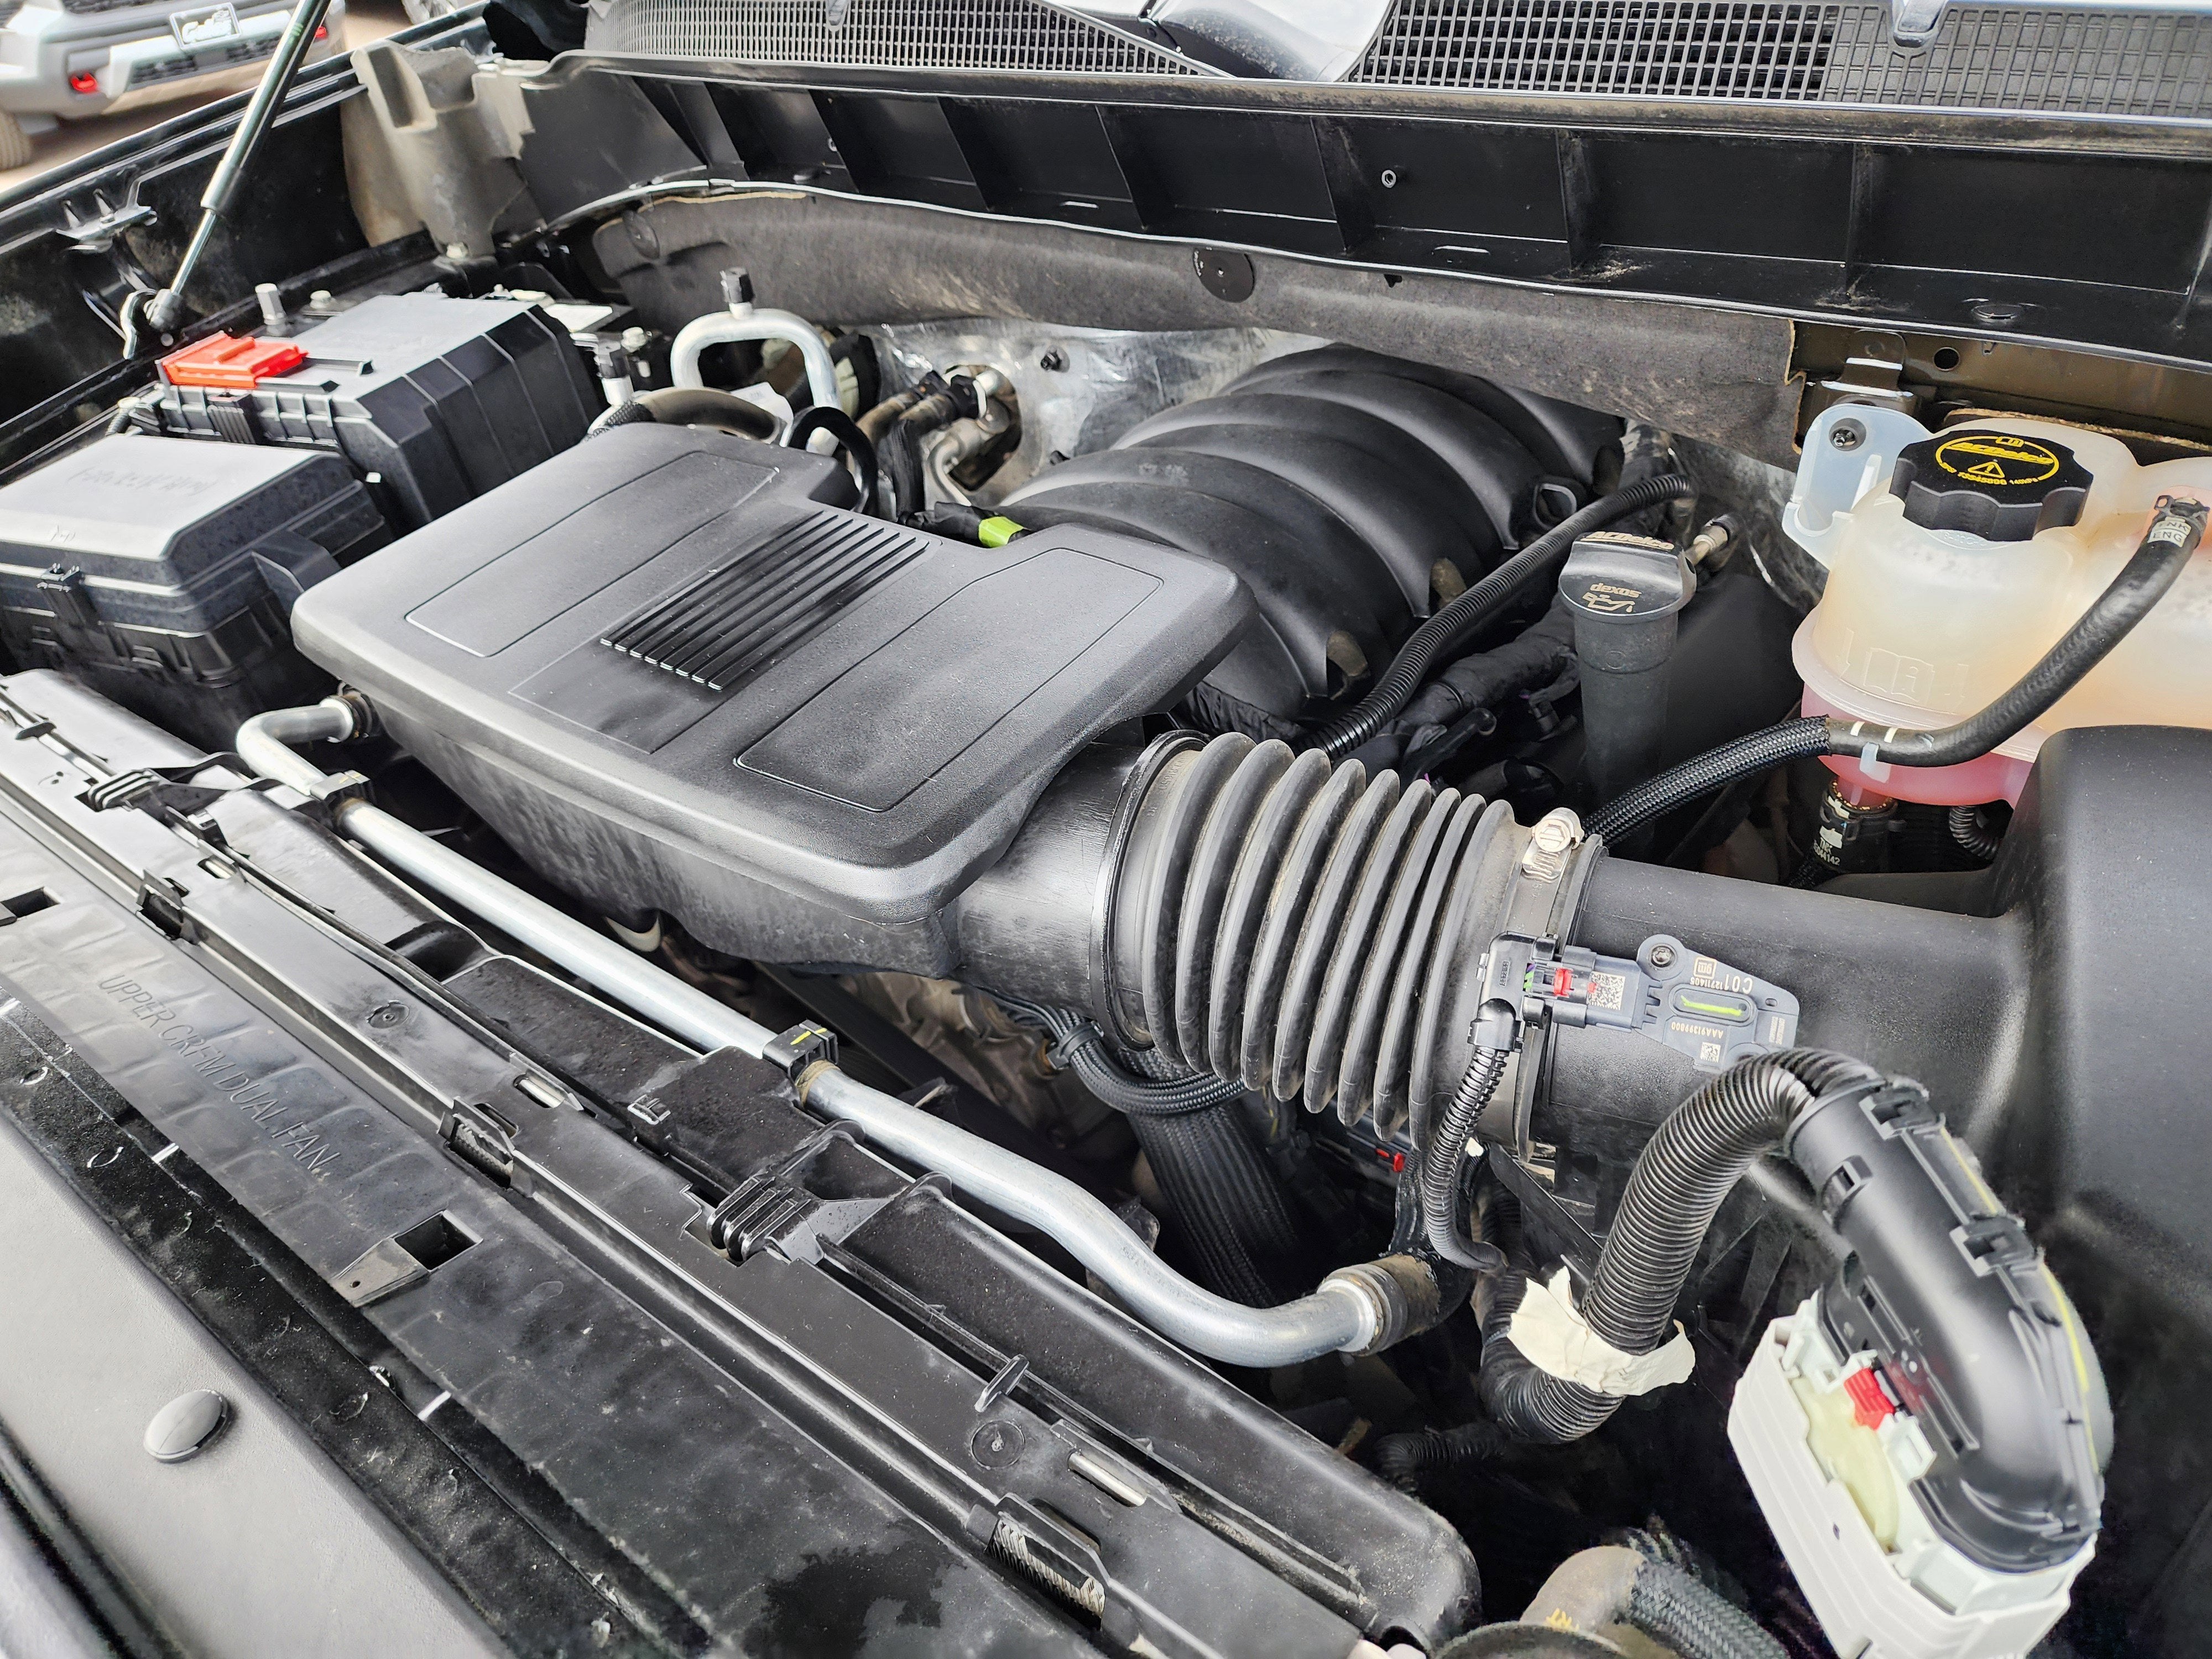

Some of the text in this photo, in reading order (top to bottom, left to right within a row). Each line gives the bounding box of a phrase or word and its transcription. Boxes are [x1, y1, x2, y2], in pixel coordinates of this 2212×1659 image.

[1949, 442, 2054, 465] ACDelco
[2158, 521, 2190, 532] NK
[1583, 531, 1674, 550] ACDelco
[2152, 531, 2183, 542] ENG
[1589, 582, 1642, 598] dexos
[98, 974, 176, 1028] UPPER
[213, 1071, 289, 1130] DUAL
[271, 1120, 342, 1171] FAN
